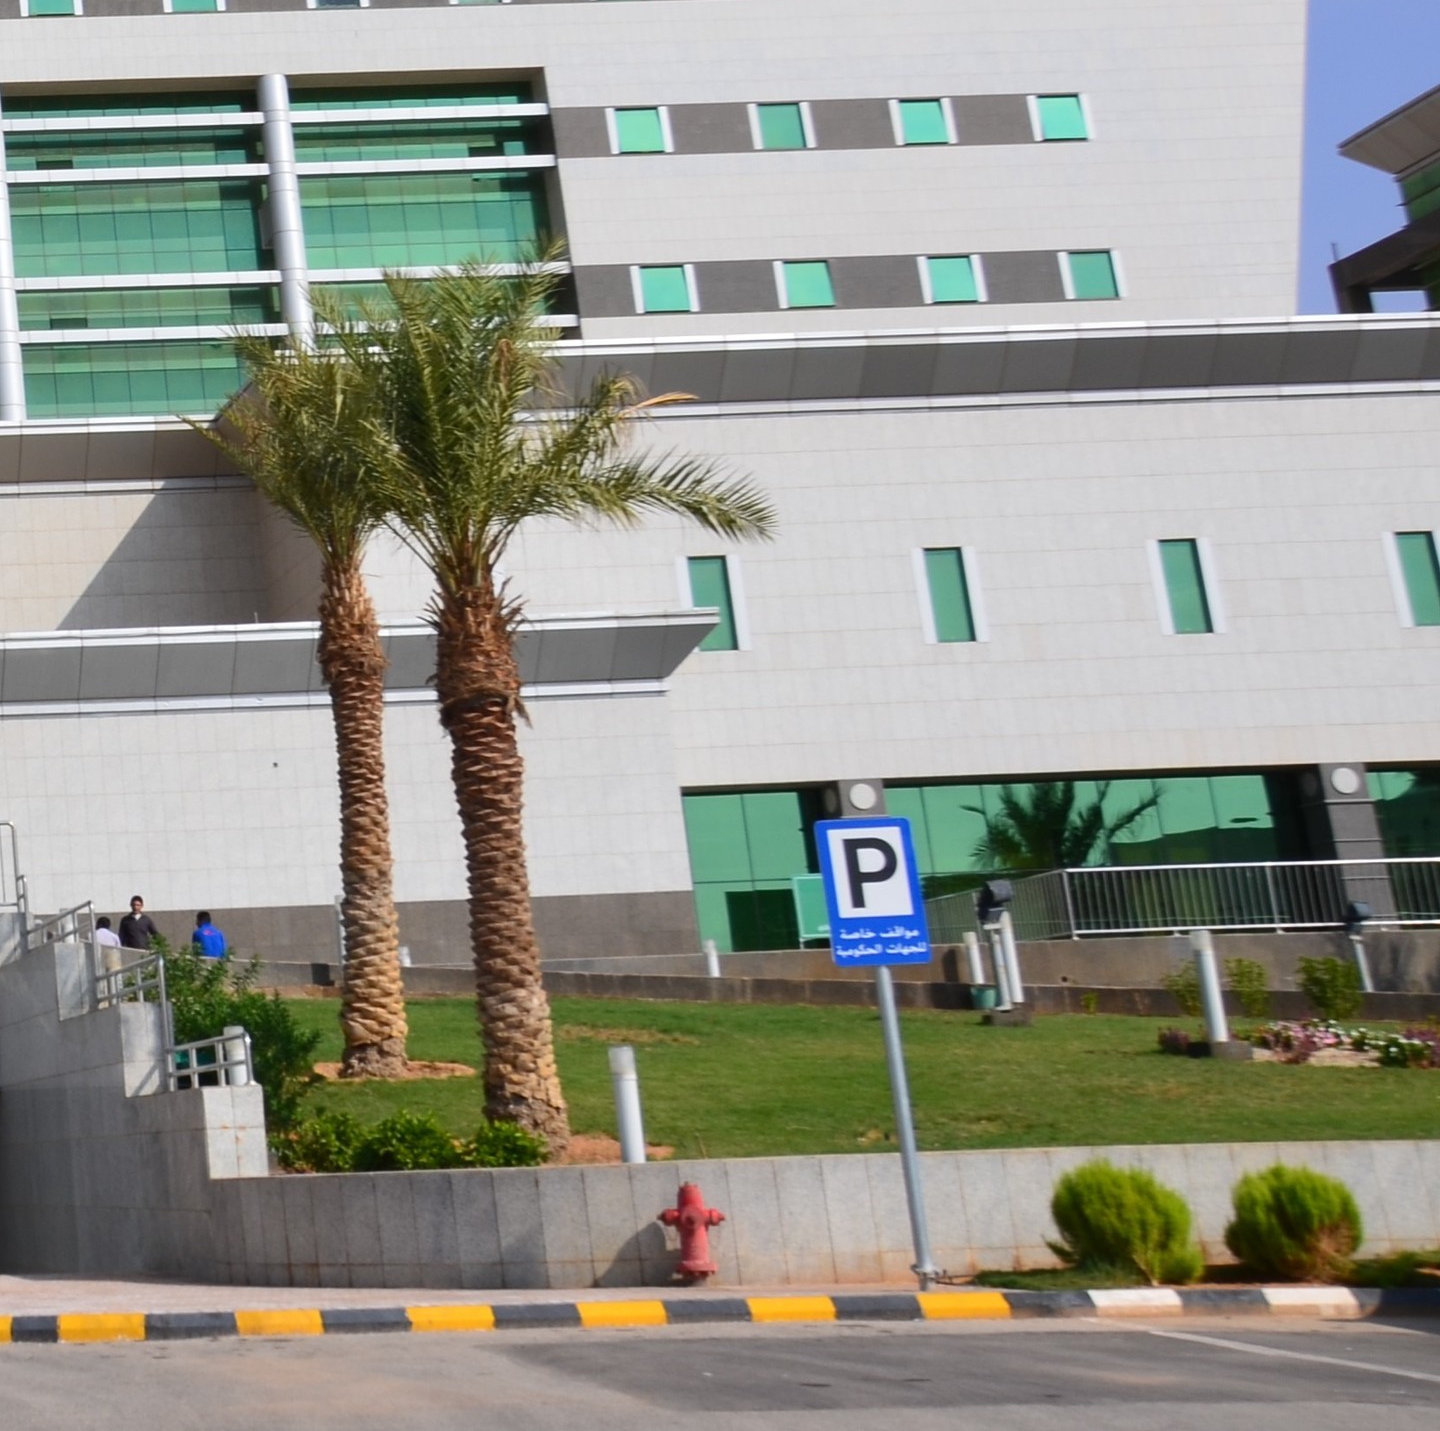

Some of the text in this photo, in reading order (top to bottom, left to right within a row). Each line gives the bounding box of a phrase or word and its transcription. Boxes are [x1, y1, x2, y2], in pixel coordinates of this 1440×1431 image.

[842, 837, 898, 909] P
[840, 925, 919, 940] مواقف خاصة
